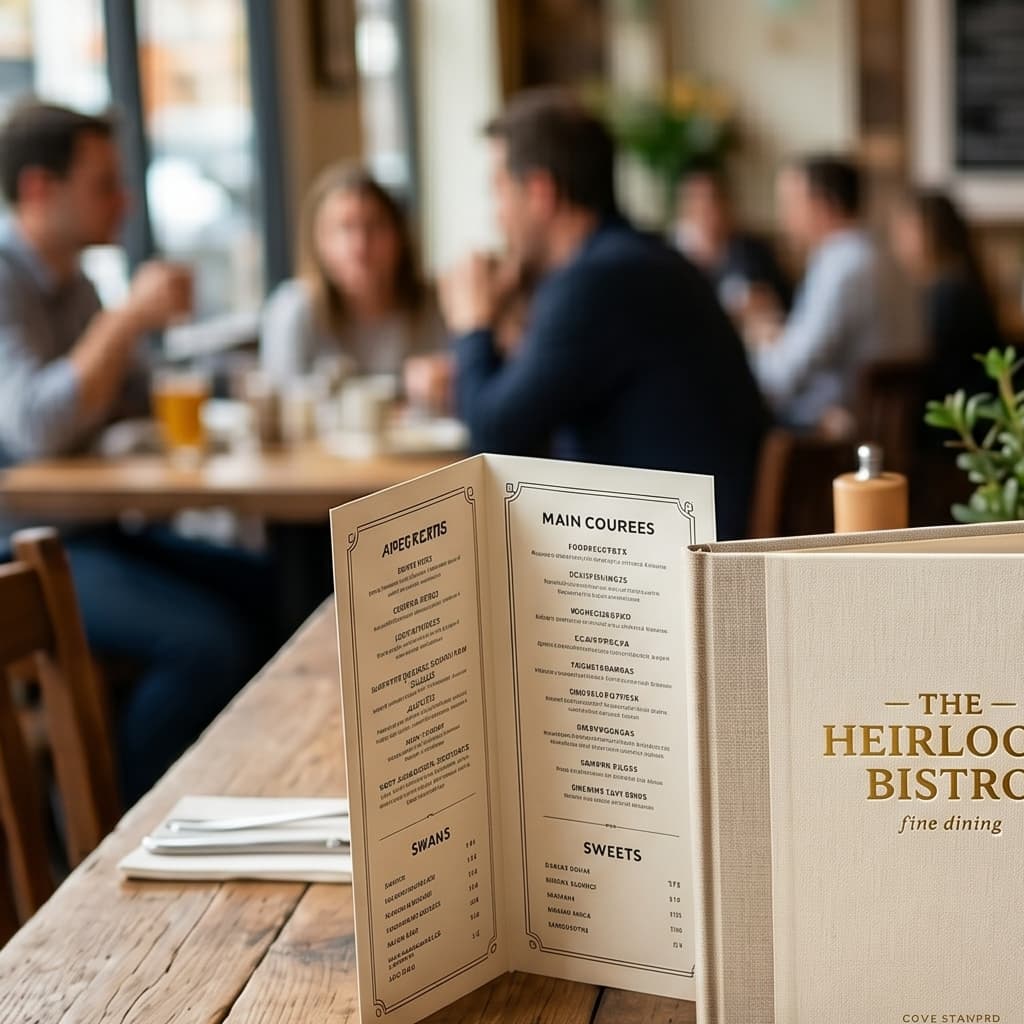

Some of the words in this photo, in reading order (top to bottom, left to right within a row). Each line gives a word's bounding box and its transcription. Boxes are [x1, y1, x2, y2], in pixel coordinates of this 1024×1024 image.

[542, 512, 580, 528] MAIN
[918, 693, 983, 714] THE
[898, 815, 937, 834] fine
[943, 815, 1002, 834] dining
[410, 827, 451, 856] SWANS
[583, 842, 642, 862] SWEETS
[902, 1014, 937, 1023] COVE
